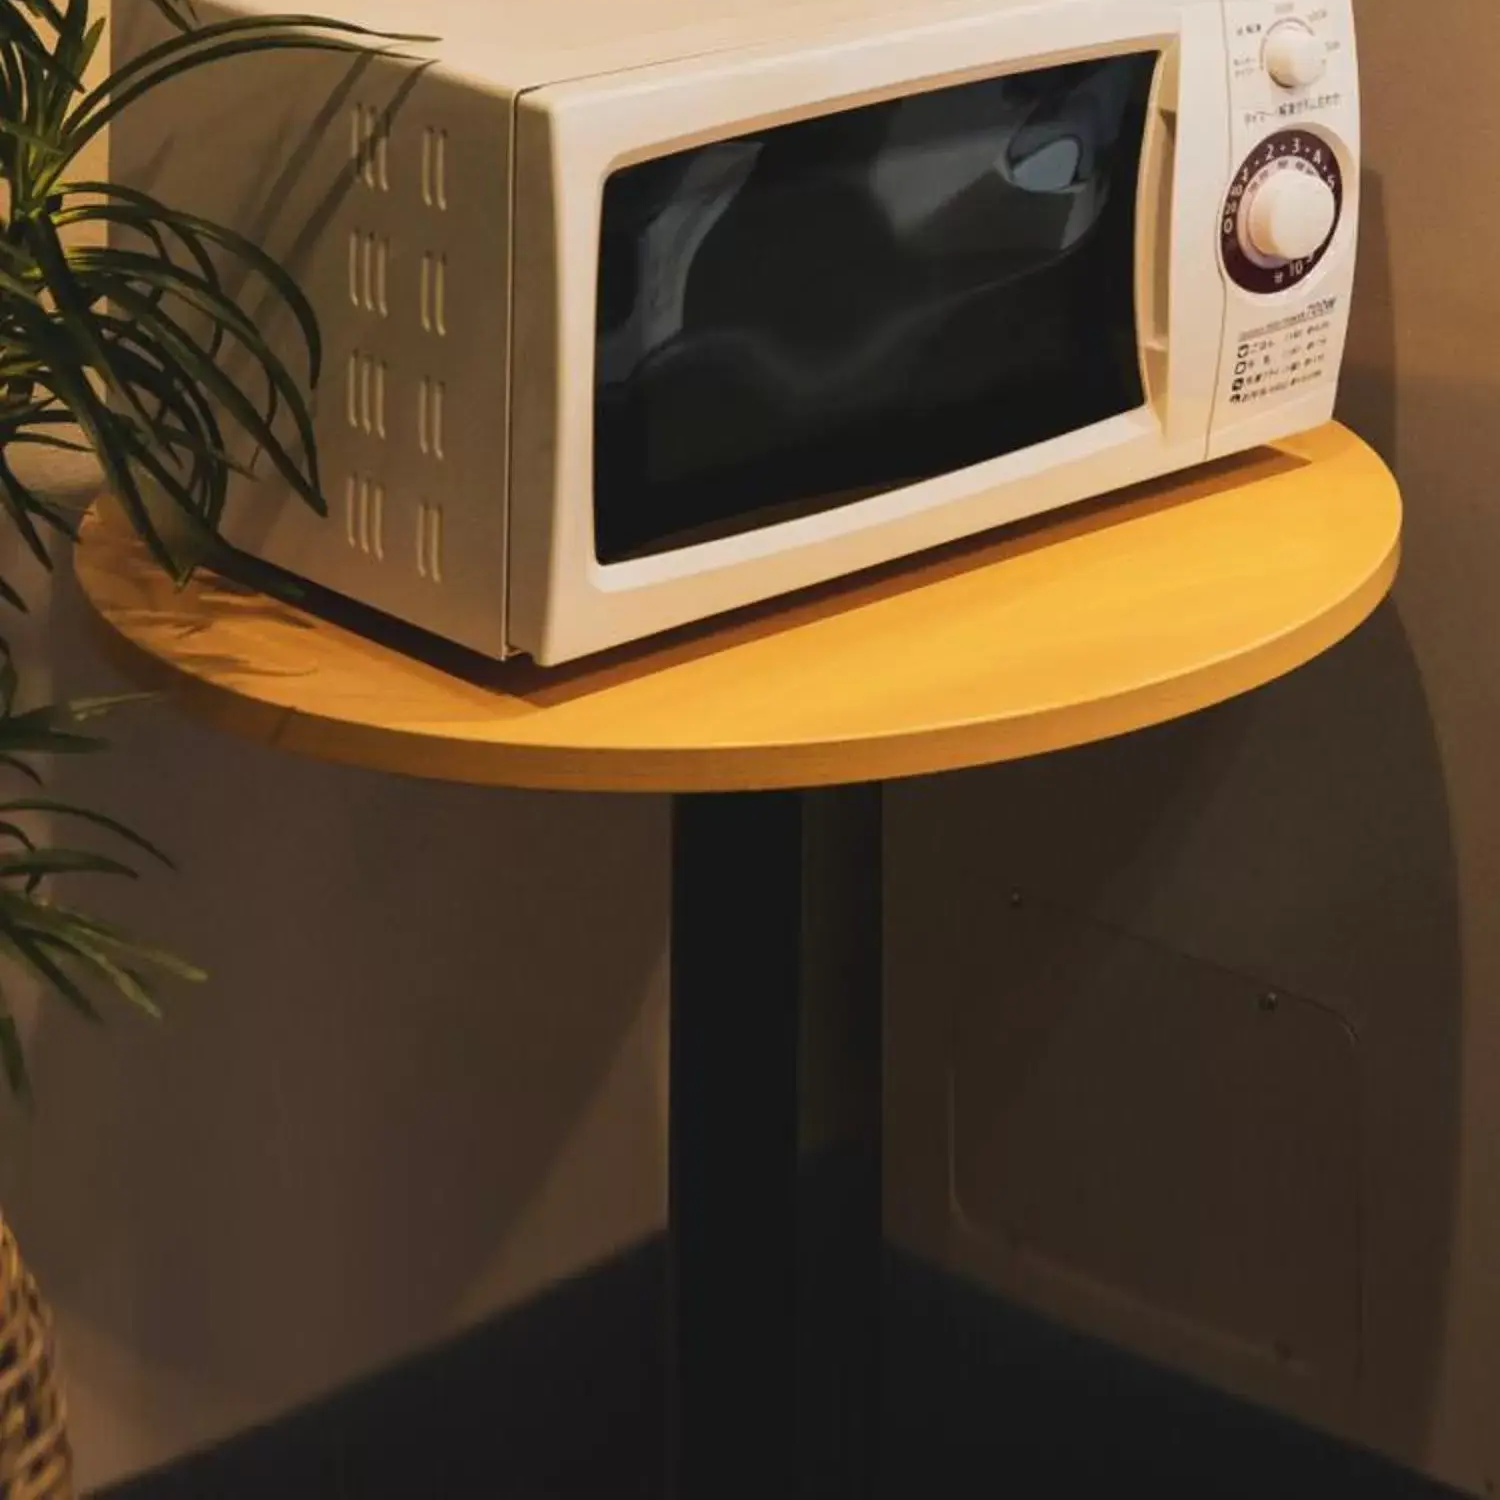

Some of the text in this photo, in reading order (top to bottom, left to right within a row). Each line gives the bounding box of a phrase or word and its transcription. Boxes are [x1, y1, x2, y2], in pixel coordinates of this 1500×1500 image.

[1265, 143, 1275, 160] 2
[1292, 138, 1300, 154] 3
[1313, 150, 1322, 164] 4
[1223, 217, 1233, 233] 0
[1289, 260, 1303, 277] 10
